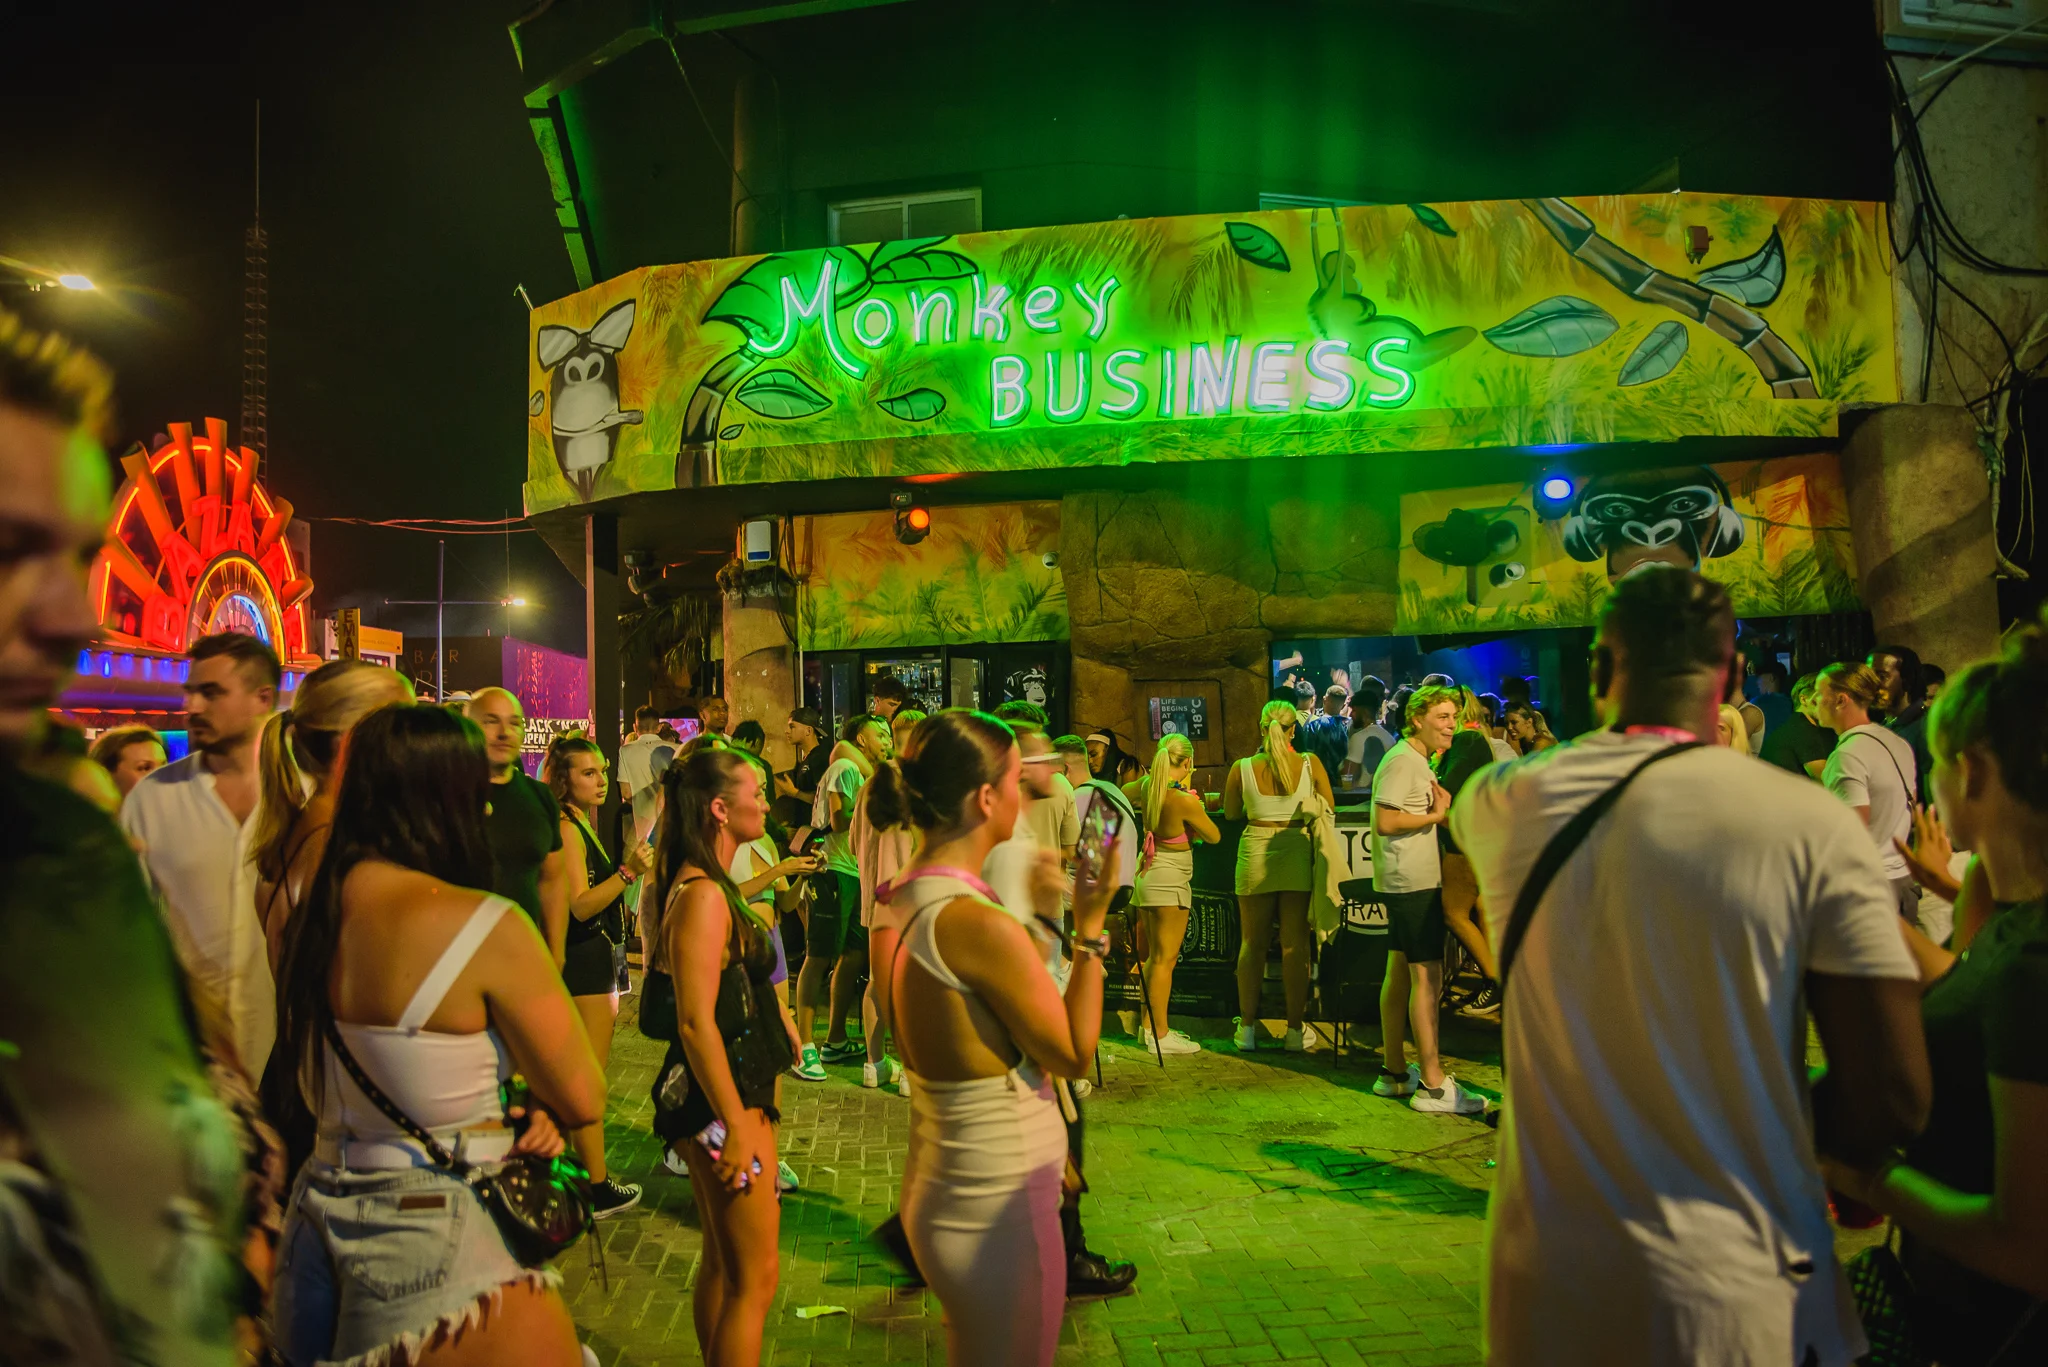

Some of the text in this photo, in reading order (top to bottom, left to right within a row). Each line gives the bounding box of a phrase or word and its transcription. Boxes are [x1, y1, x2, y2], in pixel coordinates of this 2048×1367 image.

[747, 250, 1121, 381] Monkey
[989, 335, 1416, 428] BUSINESS
[522, 718, 554, 732] LACK
[524, 733, 546, 744] PEN
